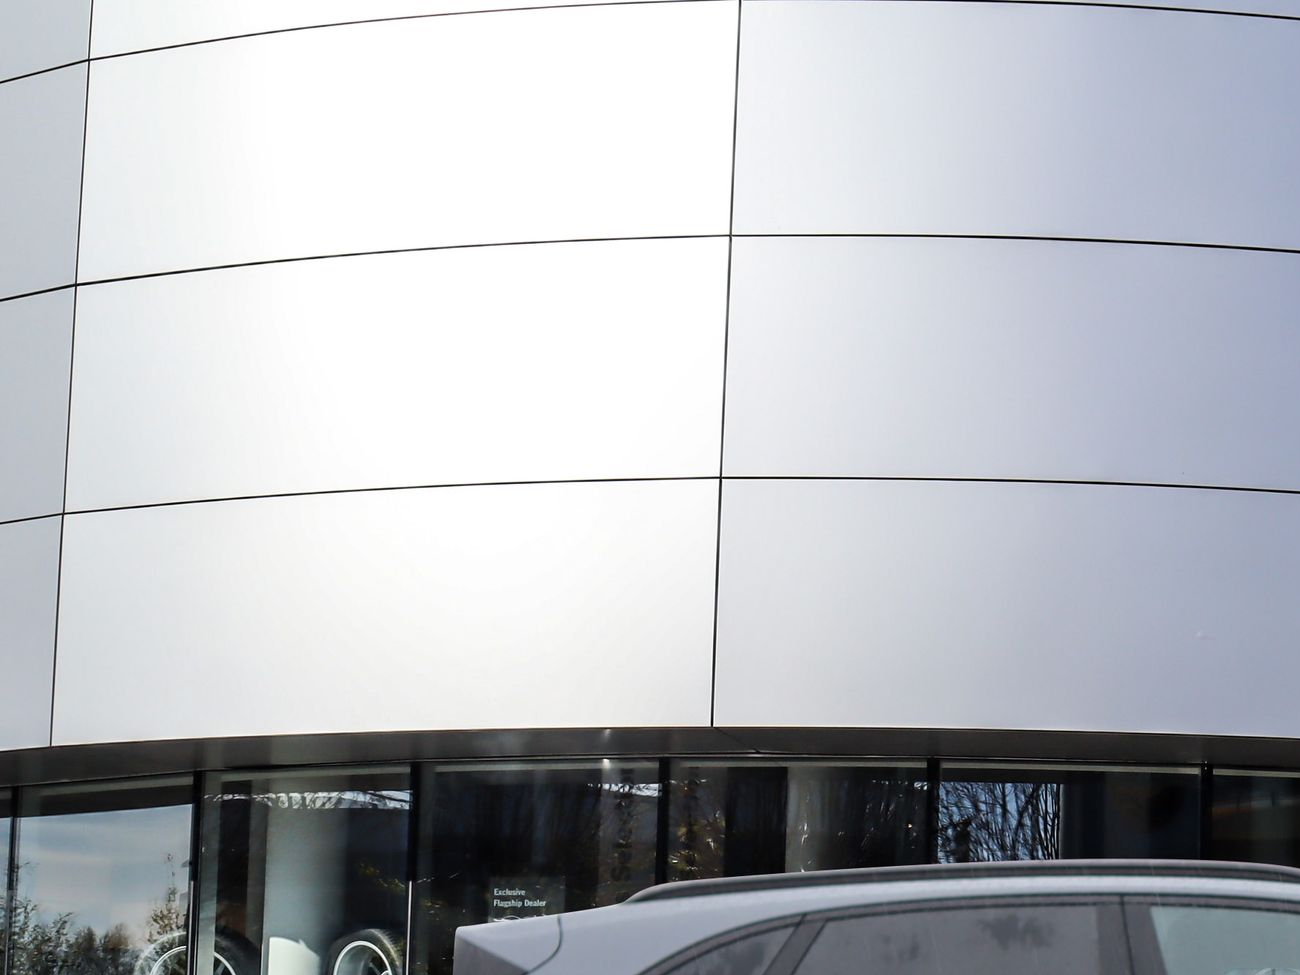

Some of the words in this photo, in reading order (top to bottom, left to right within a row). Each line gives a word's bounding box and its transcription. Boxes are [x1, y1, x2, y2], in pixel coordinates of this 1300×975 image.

[493, 888, 526, 896] Exclusive
[493, 899, 522, 908] Flagship
[524, 899, 546, 907] Dealer
